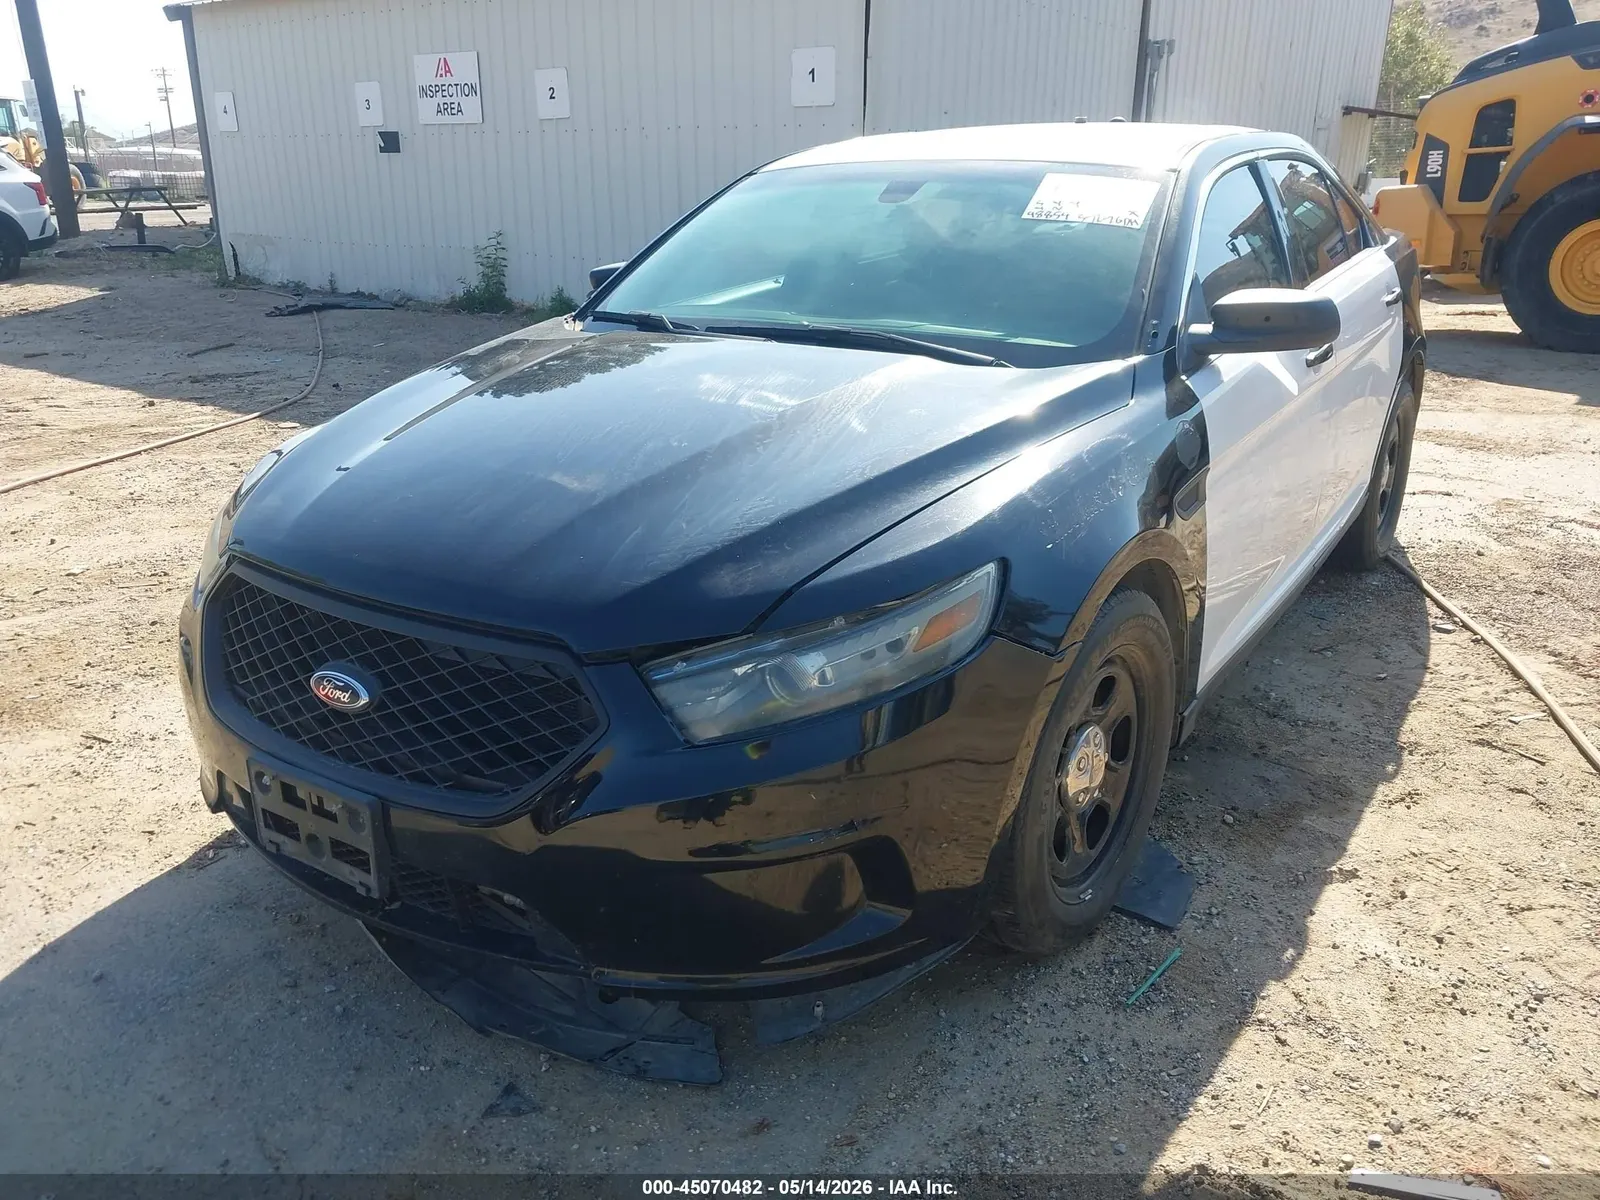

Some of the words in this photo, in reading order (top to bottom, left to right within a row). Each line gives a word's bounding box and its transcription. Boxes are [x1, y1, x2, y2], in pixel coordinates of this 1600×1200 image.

[808, 67, 816, 83] 1
[418, 82, 478, 99] INSPECTION
[548, 86, 556, 100] 2
[223, 105, 228, 115] 4
[364, 98, 371, 110] 3
[436, 101, 464, 117] AREA
[1426, 150, 1444, 178] L90H
[320, 677, 353, 703] Ford
